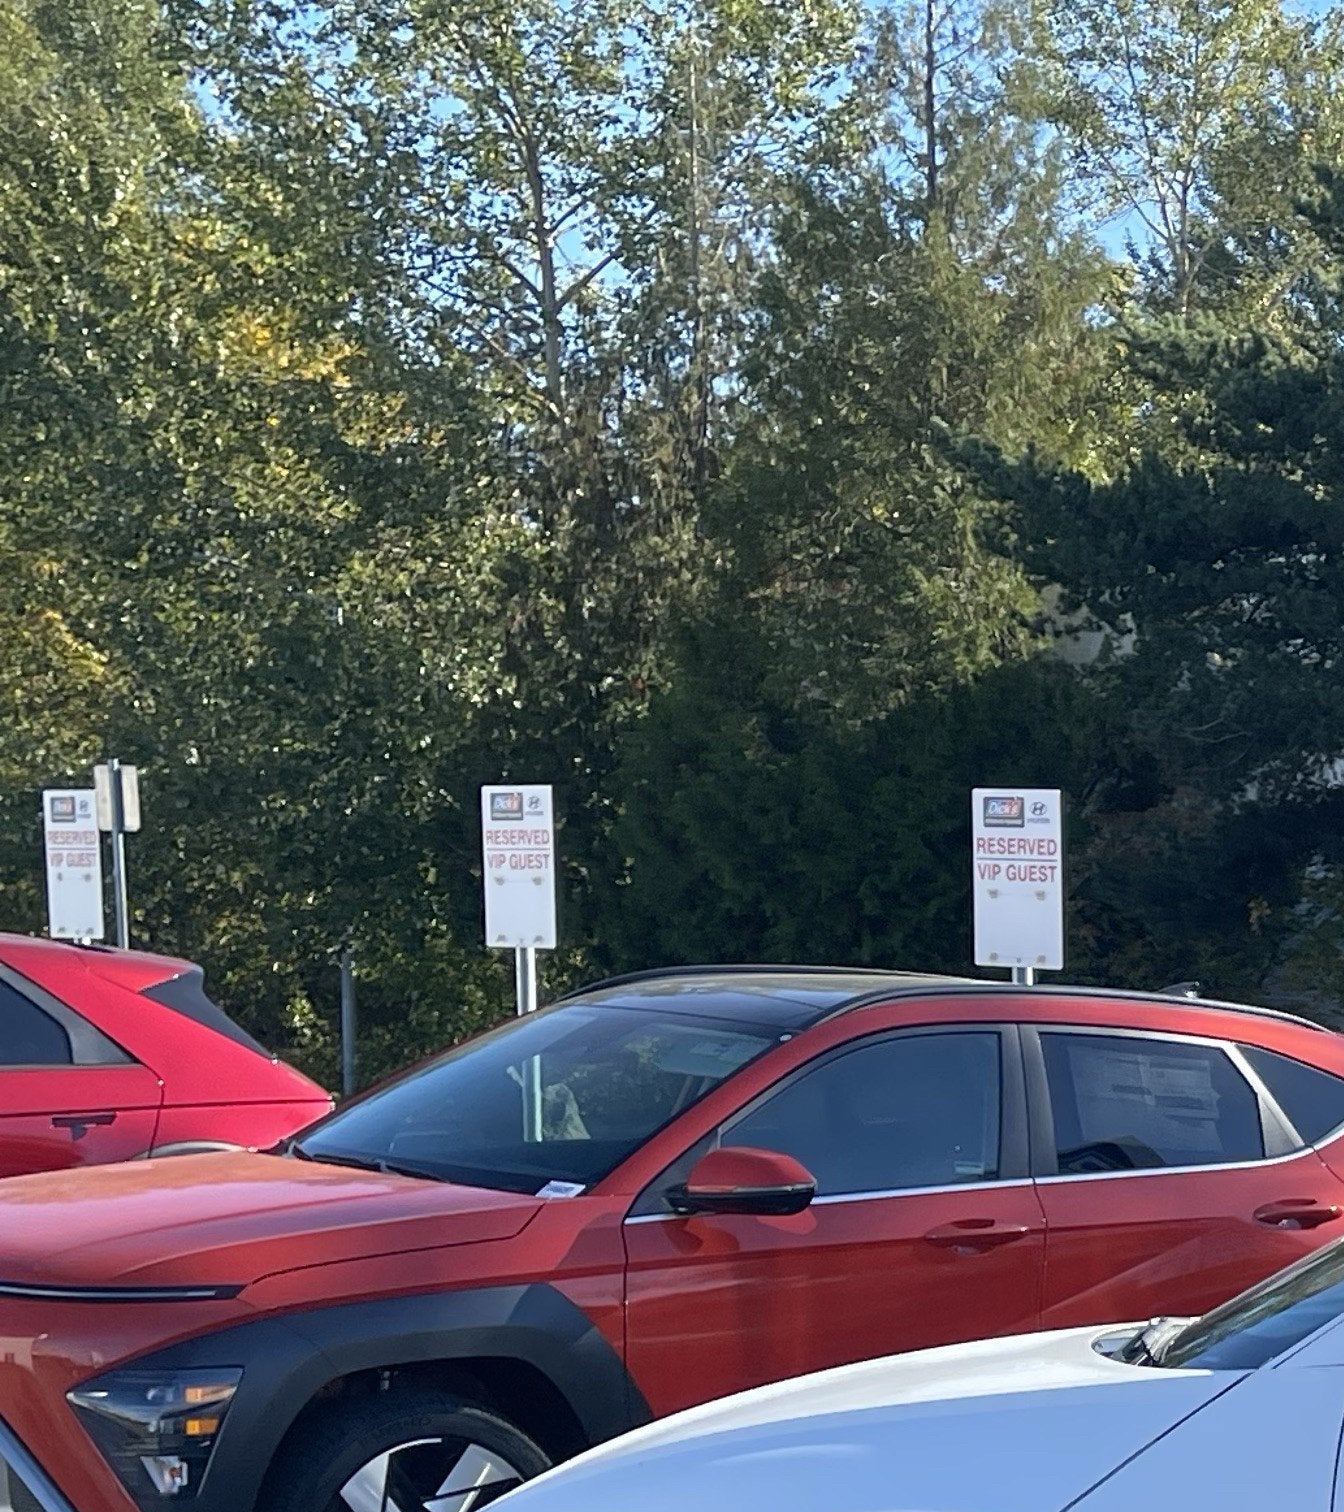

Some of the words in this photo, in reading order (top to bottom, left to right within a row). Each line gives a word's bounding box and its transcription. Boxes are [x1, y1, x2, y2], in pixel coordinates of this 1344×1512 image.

[486, 829, 550, 845] RESERVED
[976, 837, 1057, 855] RESERVED
[509, 853, 550, 870] GUEST
[978, 864, 1002, 880] VIP
[1006, 865, 1058, 882] GUEST
